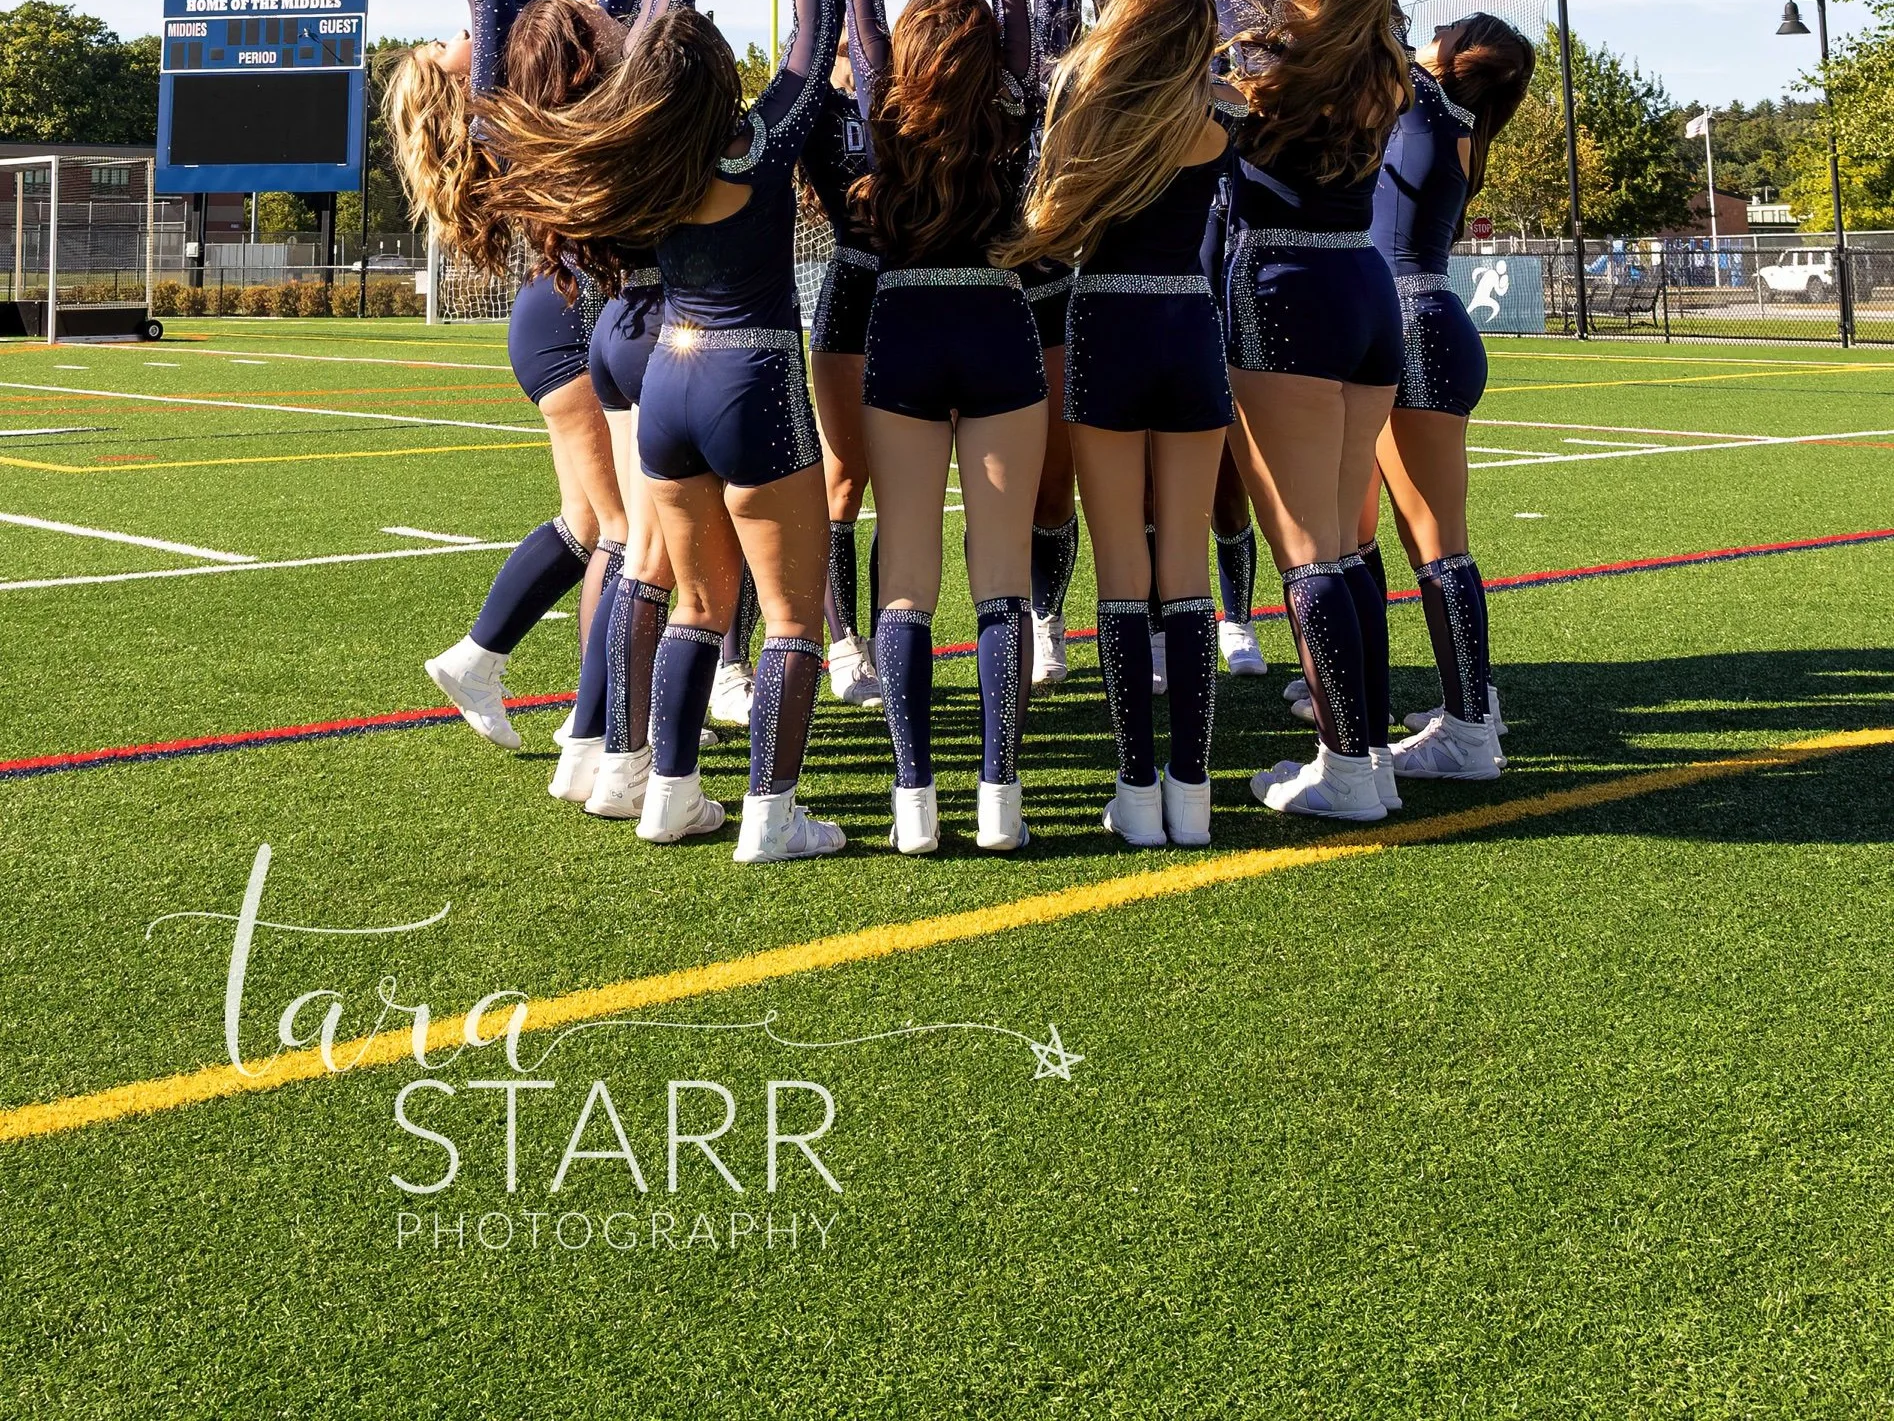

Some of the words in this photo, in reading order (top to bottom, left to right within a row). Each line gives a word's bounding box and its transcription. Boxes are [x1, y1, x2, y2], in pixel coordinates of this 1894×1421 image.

[167, 22, 208, 37] MIDDIES
[319, 18, 359, 34] GUEST
[238, 51, 277, 64] PERIOD
[1473, 224, 1492, 233] STOP
